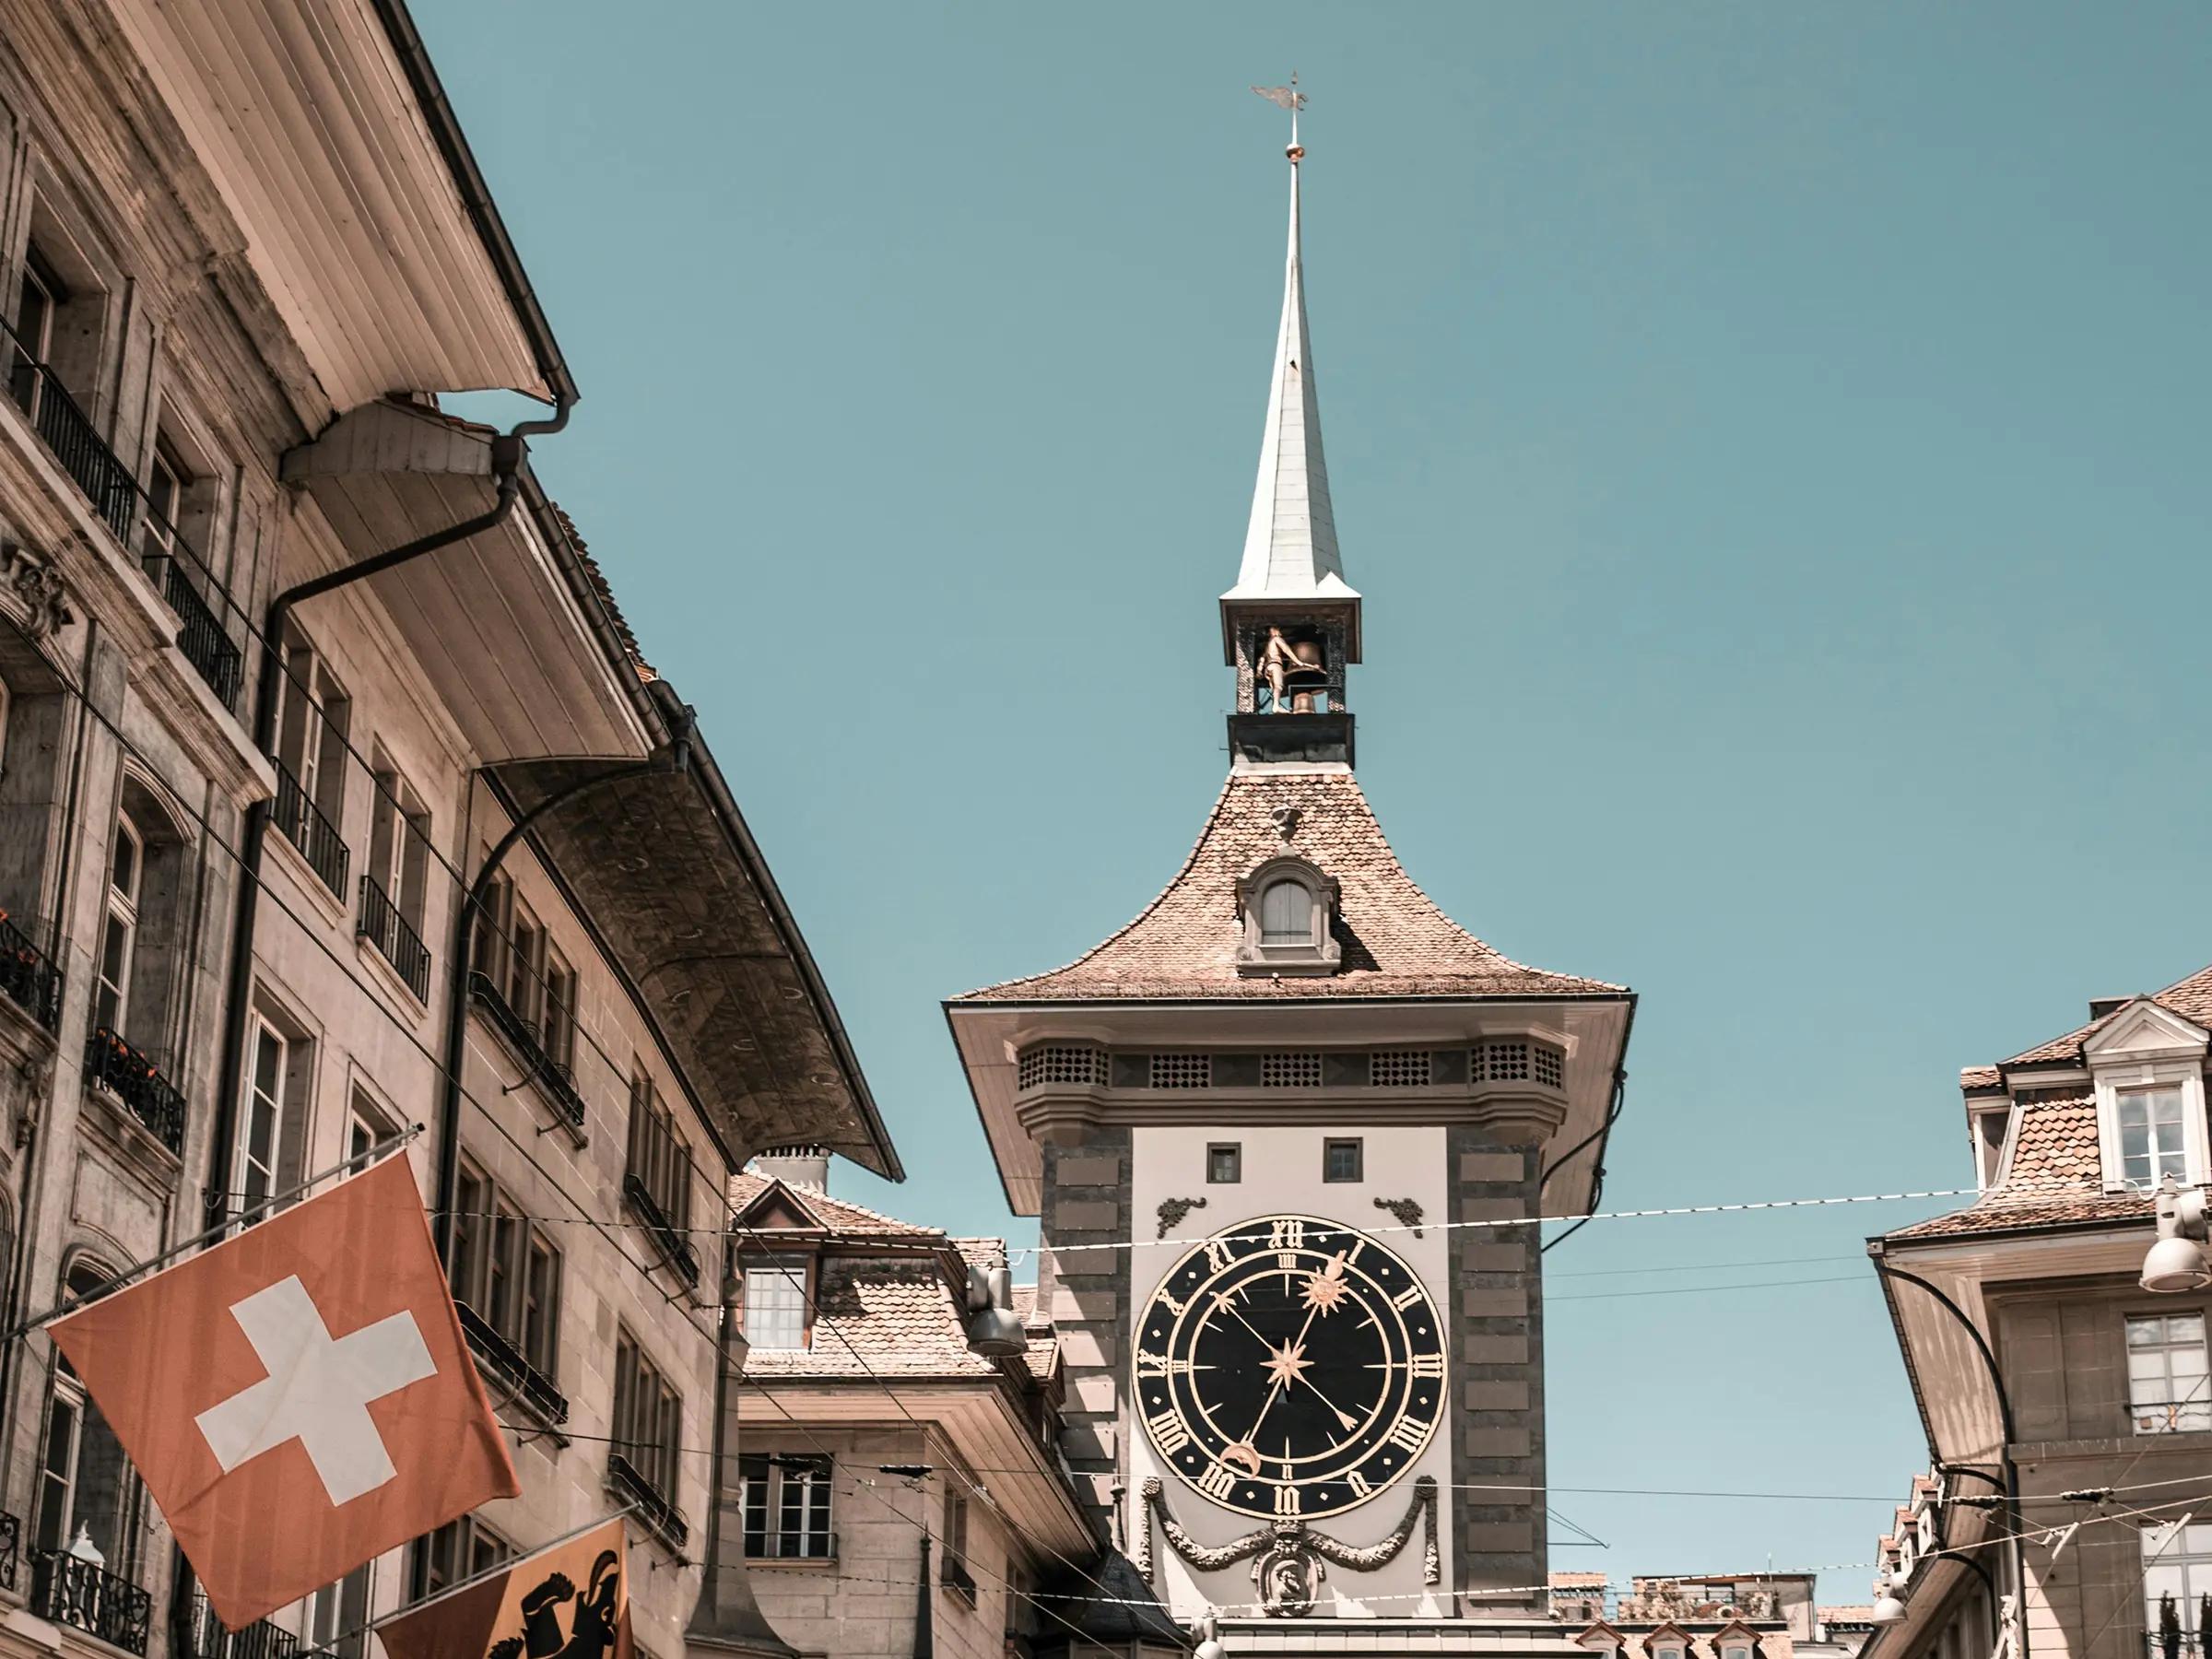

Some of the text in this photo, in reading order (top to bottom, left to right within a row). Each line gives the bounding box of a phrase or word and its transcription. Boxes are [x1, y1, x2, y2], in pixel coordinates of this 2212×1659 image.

[1203, 1238, 1236, 1274] XI
[1157, 1288, 1184, 1316] X
[1393, 1285, 1423, 1312] II
[1412, 1351, 1443, 1379] III
